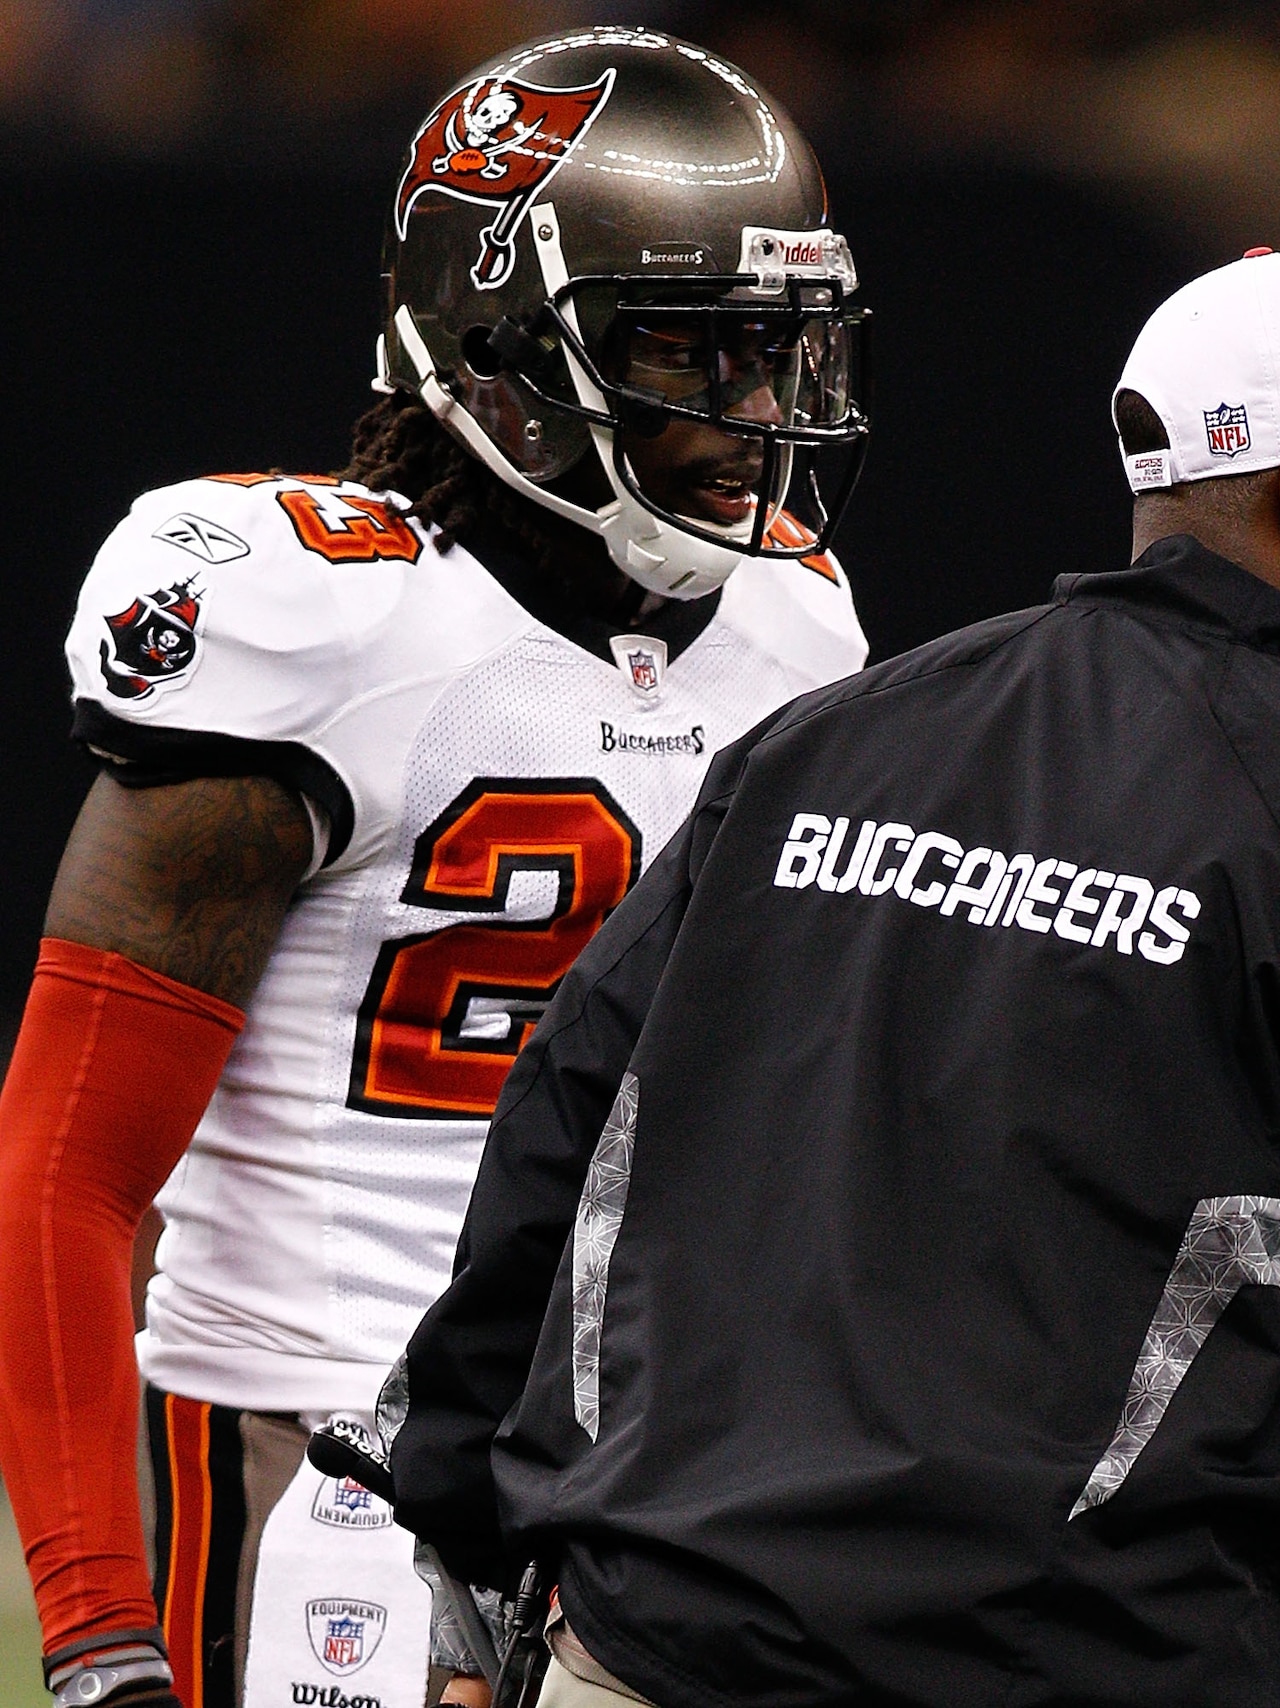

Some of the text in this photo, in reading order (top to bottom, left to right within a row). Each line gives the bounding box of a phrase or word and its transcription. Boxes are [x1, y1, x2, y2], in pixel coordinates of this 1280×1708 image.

[1210, 425, 1248, 452] NFL
[773, 811, 1203, 966] BUCCANEERS
[317, 1505, 388, 1526] EQUIPMENT
[311, 1602, 384, 1622] EQUIPMENT
[326, 1637, 361, 1665] NFL
[290, 1682, 383, 1708] Wilson
